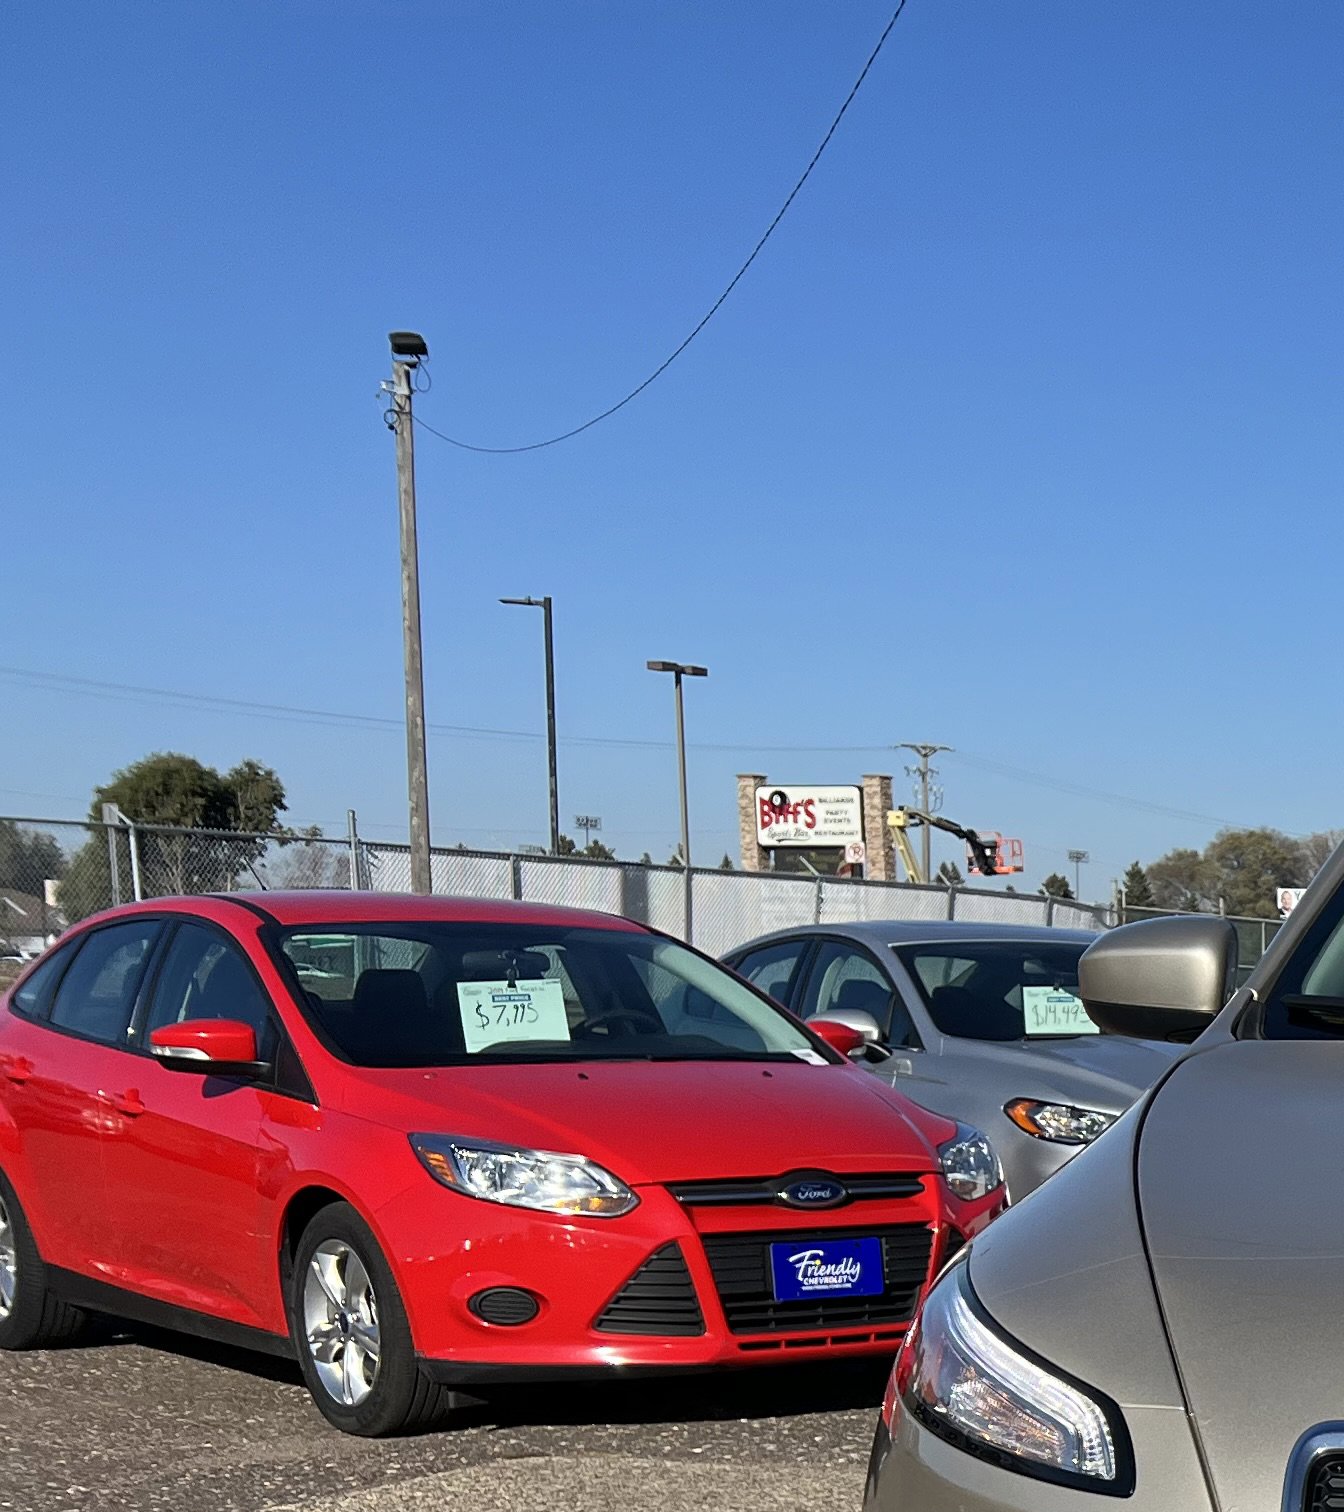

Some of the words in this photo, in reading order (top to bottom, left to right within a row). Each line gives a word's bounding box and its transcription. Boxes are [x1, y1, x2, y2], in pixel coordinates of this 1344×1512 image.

[798, 1184, 832, 1199] Ford
[788, 1249, 861, 1283] Friendly
[803, 1275, 849, 1286] CHEVROLET
